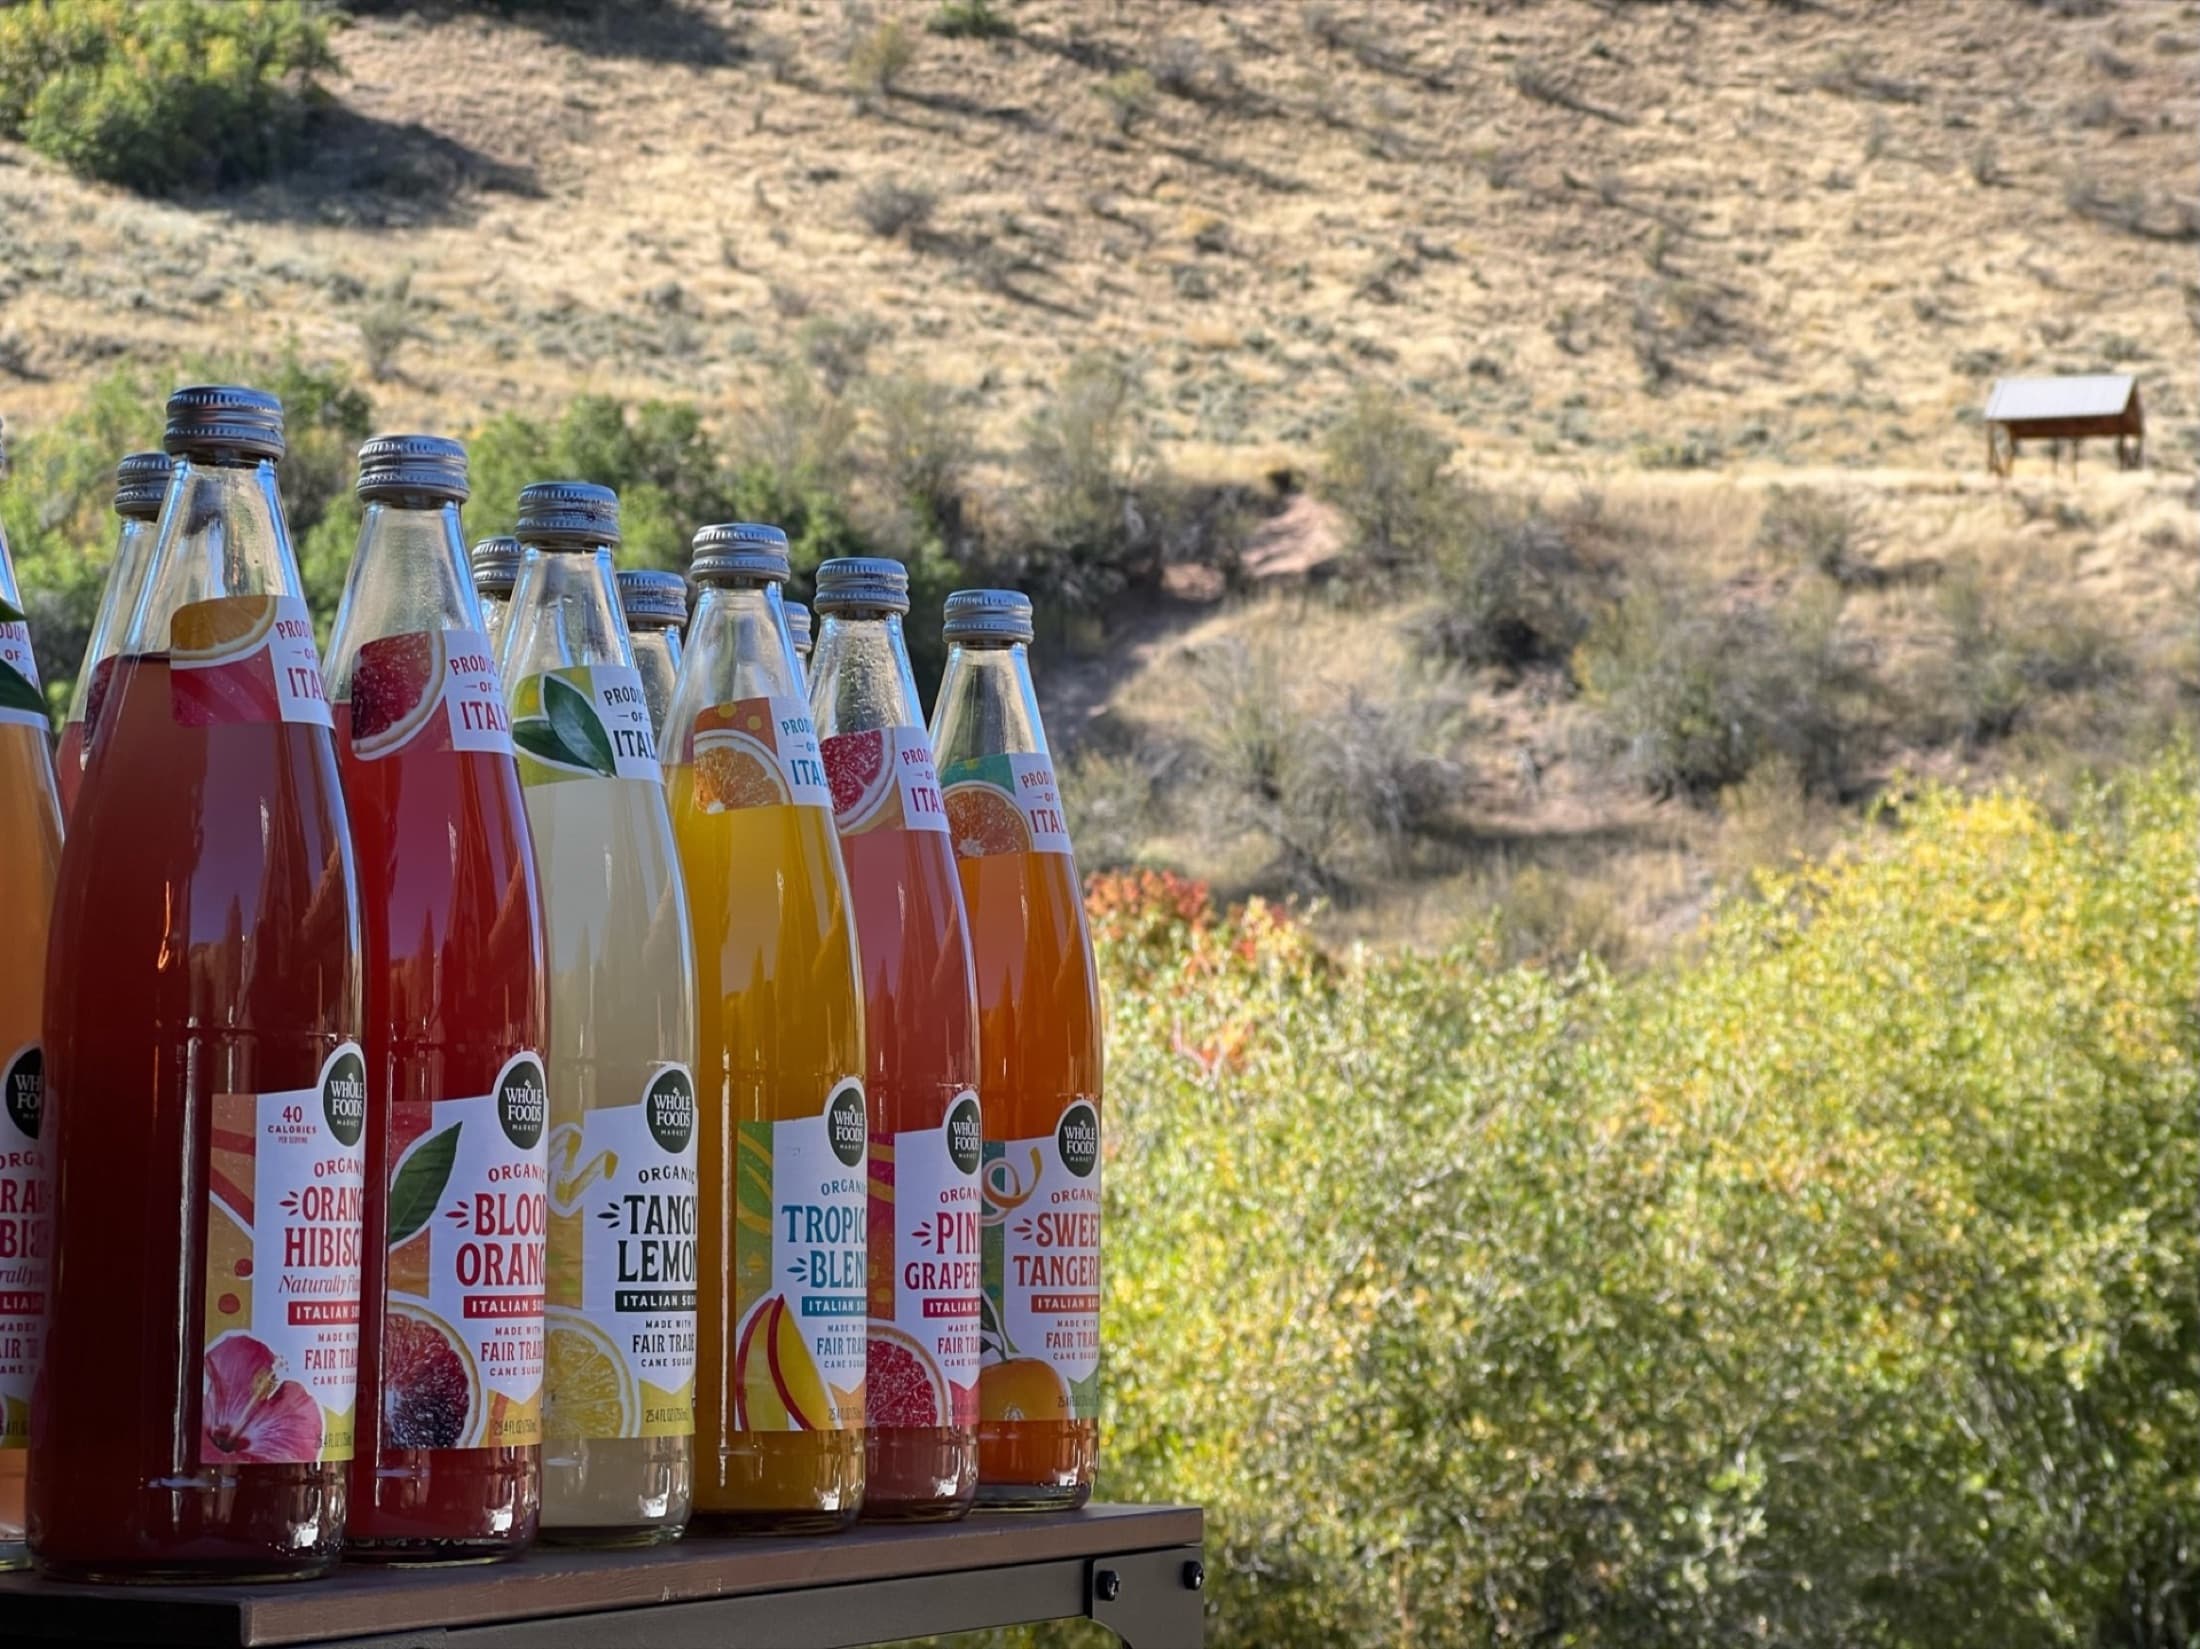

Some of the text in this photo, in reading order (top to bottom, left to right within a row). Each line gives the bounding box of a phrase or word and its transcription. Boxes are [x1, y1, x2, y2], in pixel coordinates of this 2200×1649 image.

[5, 649, 21, 662] OF
[479, 682, 493, 693] OF
[461, 701, 510, 733] ITAL
[631, 712, 644, 722] OF
[330, 1079, 363, 1099] WHOLE
[505, 1086, 542, 1105] WHOLE
[332, 1099, 363, 1118] FOODS
[654, 1093, 691, 1111] WHOLE
[282, 1105, 303, 1123] 40
[507, 1105, 542, 1122] FOODS
[656, 1111, 690, 1128] FOODS
[833, 1109, 864, 1126] WHOLE
[267, 1125, 317, 1135] CALORIES
[512, 1123, 539, 1132] MARKET
[660, 1129, 687, 1137] MARKET
[835, 1126, 864, 1142] FOODS
[952, 1120, 980, 1138] WHOLE
[1064, 1125, 1096, 1141] WHOLE
[1066, 1140, 1095, 1154] FOODS
[623, 1194, 698, 1235] TANGY
[781, 1204, 866, 1244] TROPIC
[936, 1211, 979, 1255] PIN
[904, 1261, 980, 1290] GRAPEF
[278, 1274, 345, 1298] Naturally
[472, 1300, 528, 1313] ITALIAN
[623, 1295, 678, 1307] ITALIAN
[808, 1300, 853, 1312] ITALIAN
[929, 1301, 973, 1313] ITALIAN
[1037, 1297, 1084, 1310] ITALIAN
[296, 1306, 348, 1320] ITALIAN
[645, 1319, 672, 1329] MADE
[827, 1324, 849, 1333] MADE
[947, 1324, 968, 1333] MADE
[1057, 1319, 1079, 1328] MADE
[318, 1333, 342, 1342] MADE
[495, 1327, 521, 1336] MADE
[632, 1334, 665, 1354] FAIR
[817, 1337, 844, 1356] FAIR
[937, 1337, 963, 1355] FAIR
[1045, 1332, 1073, 1349] FAIR
[481, 1342, 515, 1362] FAIR
[1053, 1353, 1075, 1361] CANE
[305, 1349, 336, 1370] FAIR
[641, 1358, 667, 1367] CANE
[824, 1361, 846, 1369] CANE
[944, 1359, 966, 1368] CANE
[489, 1367, 517, 1377] CANE
[313, 1376, 337, 1386] CANE
